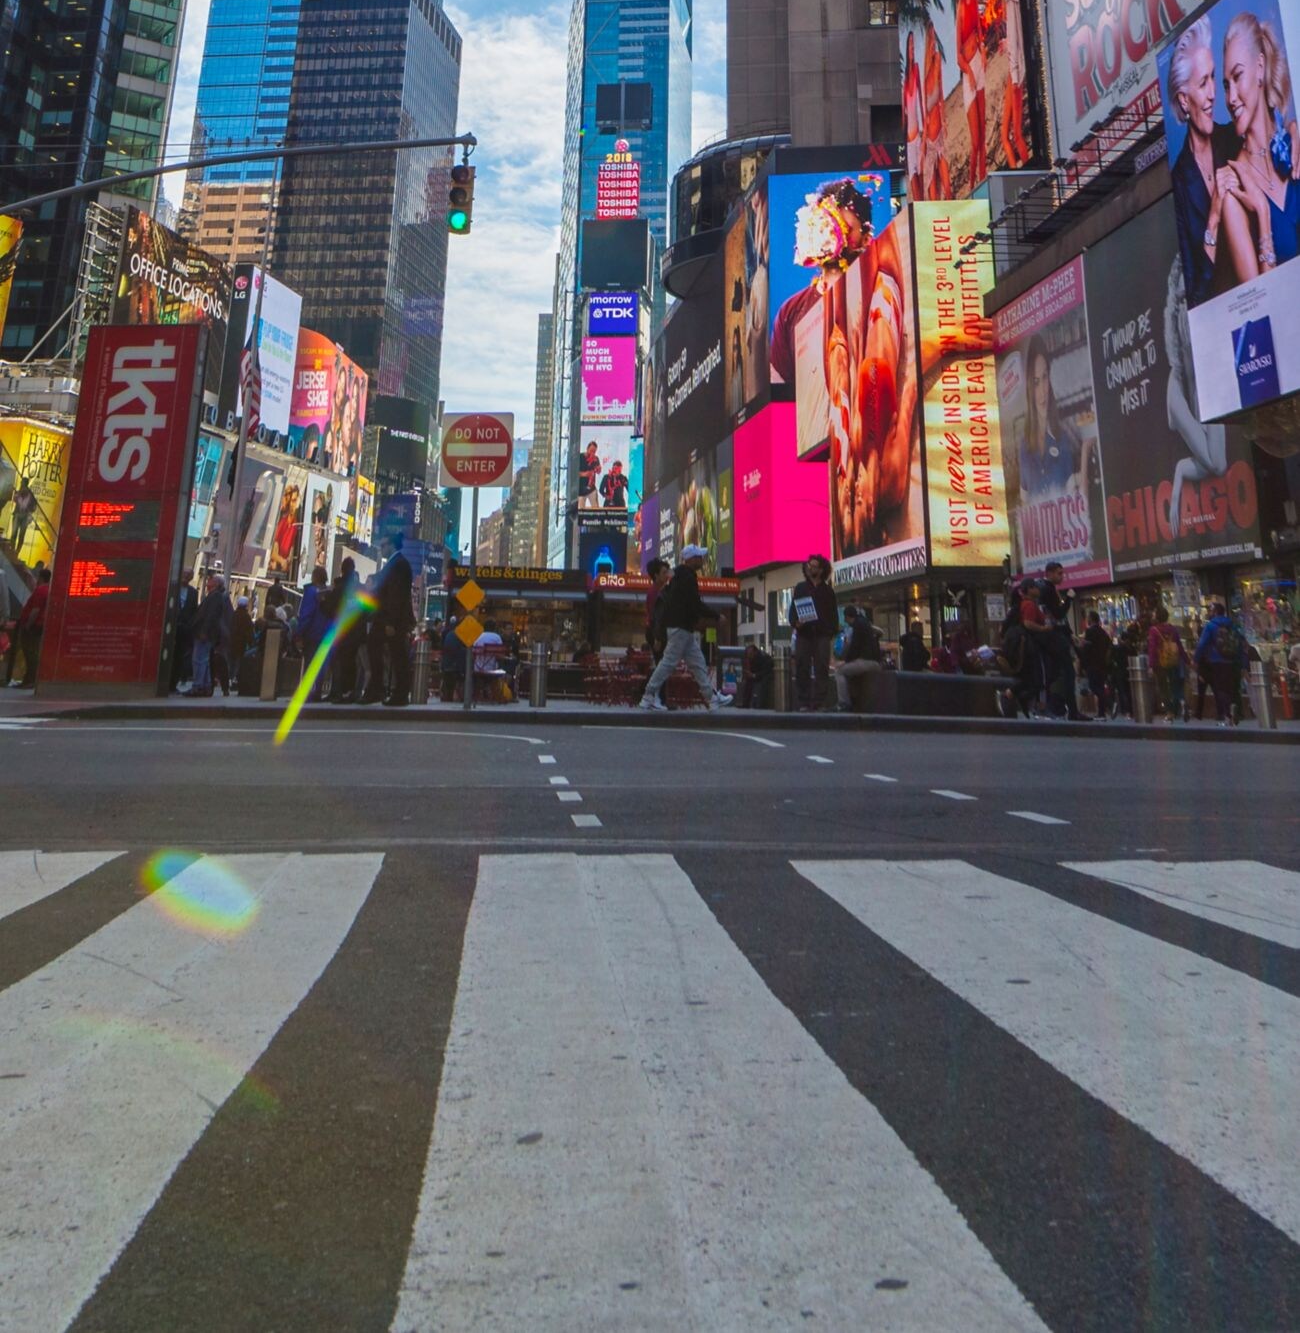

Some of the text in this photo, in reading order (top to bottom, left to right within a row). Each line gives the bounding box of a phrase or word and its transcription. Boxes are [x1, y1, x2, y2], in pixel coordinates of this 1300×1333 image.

[606, 154, 632, 162] 2018
[599, 171, 638, 179] TOSHIBA
[599, 180, 638, 188] TOSHIBA
[598, 199, 638, 207] TOSHIBA
[598, 208, 637, 216] TOSHIBA
[131, 254, 168, 288] OFFICE
[168, 273, 222, 319] LOCATIONS
[234, 291, 246, 299] LG
[603, 308, 634, 318] TDK
[997, 290, 1041, 333] KATHARINE
[1045, 288, 1076, 319] BROADWAY
[1102, 308, 1151, 360] IT WOULD BE
[297, 370, 328, 389] JERSEY
[965, 343, 985, 394] EAGLE
[1106, 339, 1156, 390] CRIMINAL TO
[1239, 354, 1273, 376] SWAROVSKI
[933, 216, 969, 548] VISIT aerie INSIDE ON THE 3RD LEVEL
[98, 339, 177, 483] tkts
[307, 390, 328, 407] SHORE
[1120, 379, 1150, 416] MISS IT
[28, 433, 66, 464] HARRY
[455, 428, 500, 439] DO NOT
[968, 402, 992, 496] AMERICAN
[22, 455, 63, 485] POTTER
[456, 460, 496, 472] ENTER
[974, 502, 994, 525] OF
[1107, 460, 1258, 552] CHICAGO
[1193, 514, 1216, 524] MUSICAL
[1019, 492, 1089, 558] WAITRESS
[882, 545, 926, 576] OUTFITTERS
